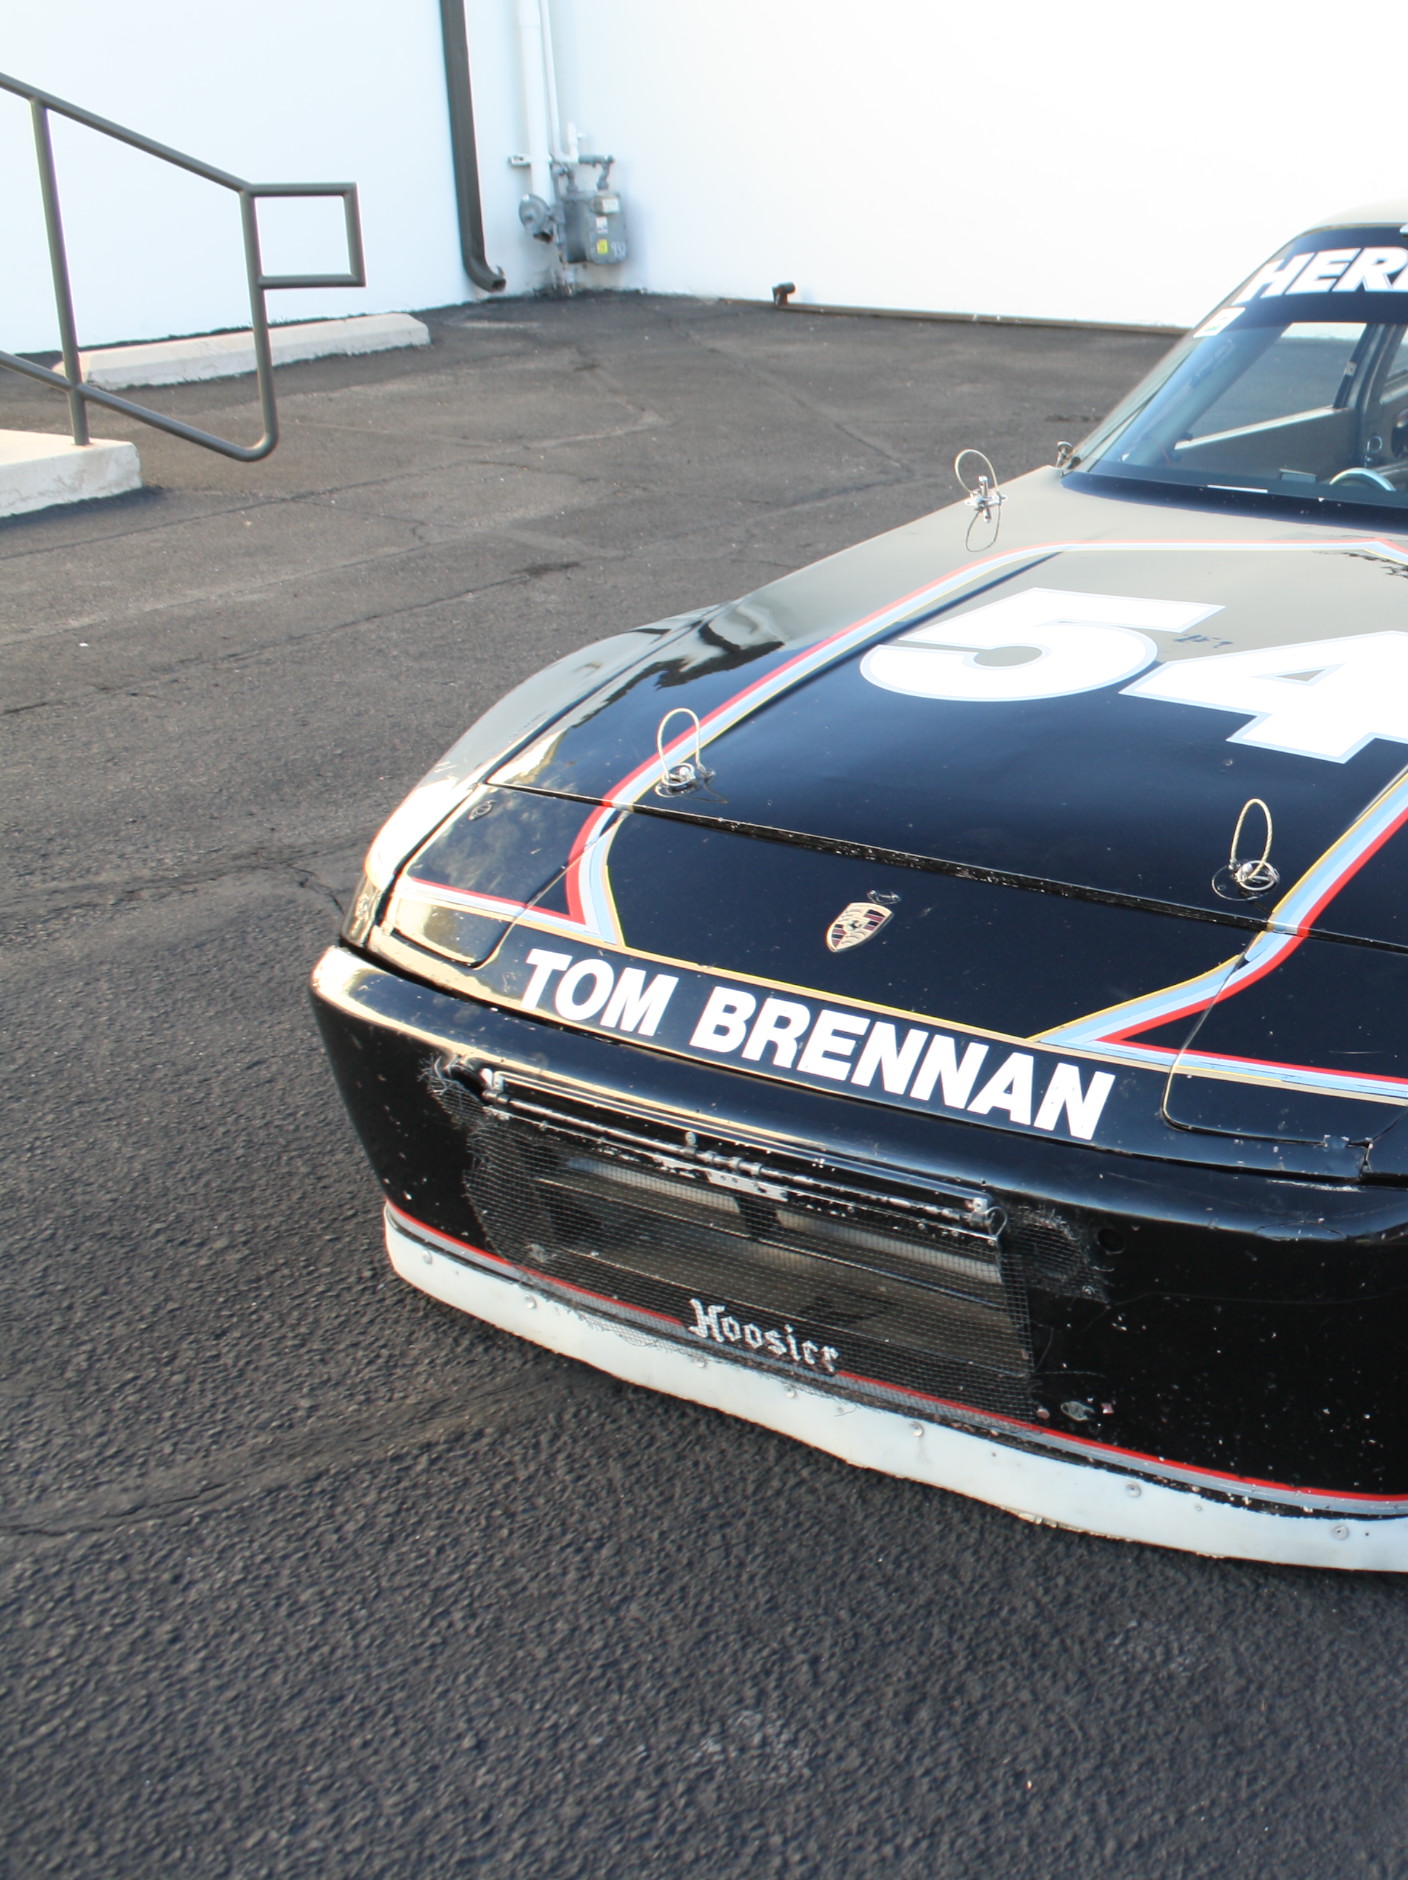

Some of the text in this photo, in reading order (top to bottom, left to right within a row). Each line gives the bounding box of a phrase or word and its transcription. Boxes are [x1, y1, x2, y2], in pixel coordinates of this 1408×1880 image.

[518, 948, 1115, 1140] TOM BRENNAN
[687, 1298, 840, 1373] Hoosier
